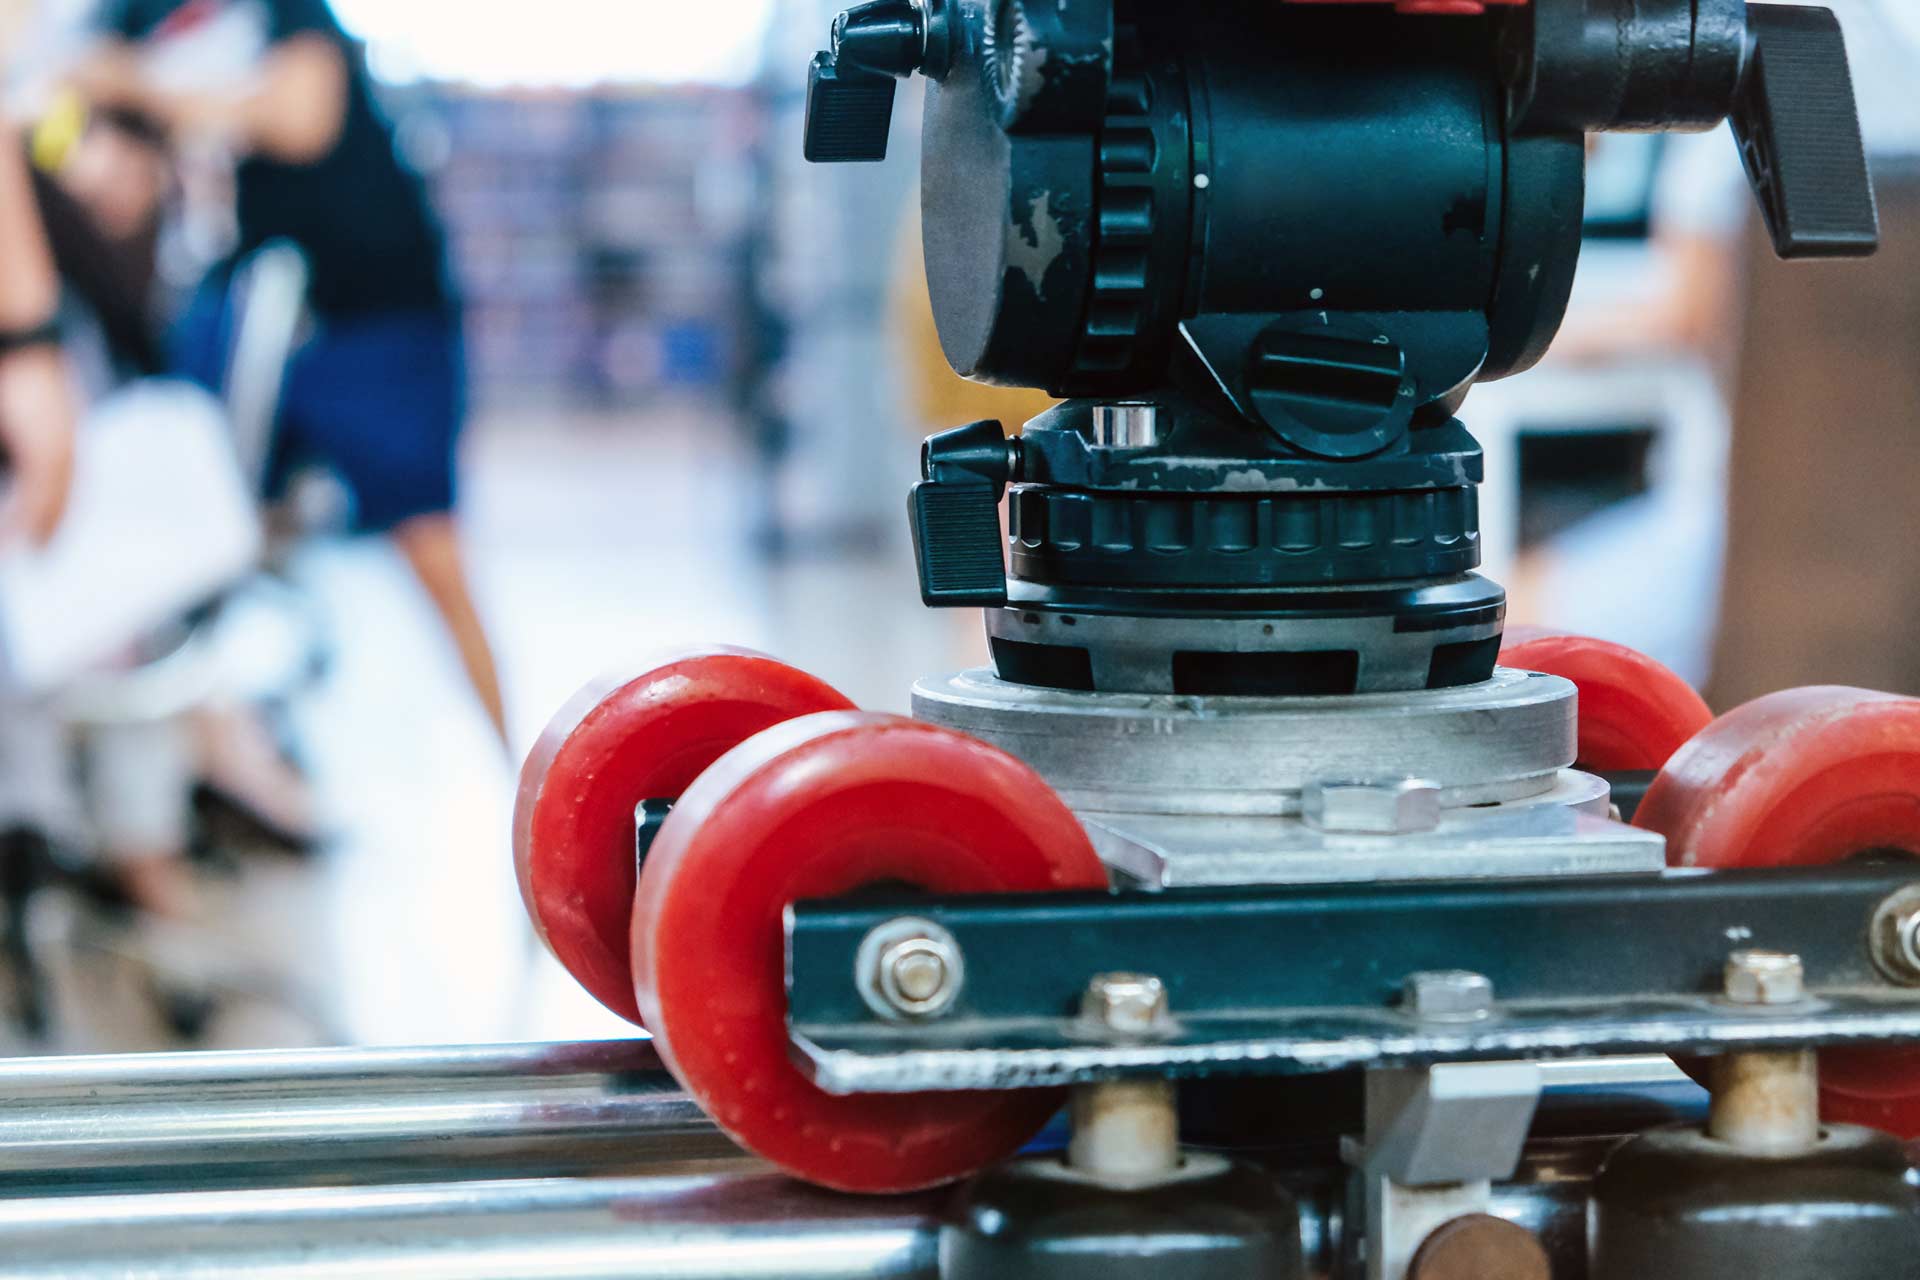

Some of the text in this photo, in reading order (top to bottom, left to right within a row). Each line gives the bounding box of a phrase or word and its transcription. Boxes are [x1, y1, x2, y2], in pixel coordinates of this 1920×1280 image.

[1318, 311, 1328, 325] 1
[1372, 335, 1389, 345] 2
[1397, 387, 1415, 397] 3
